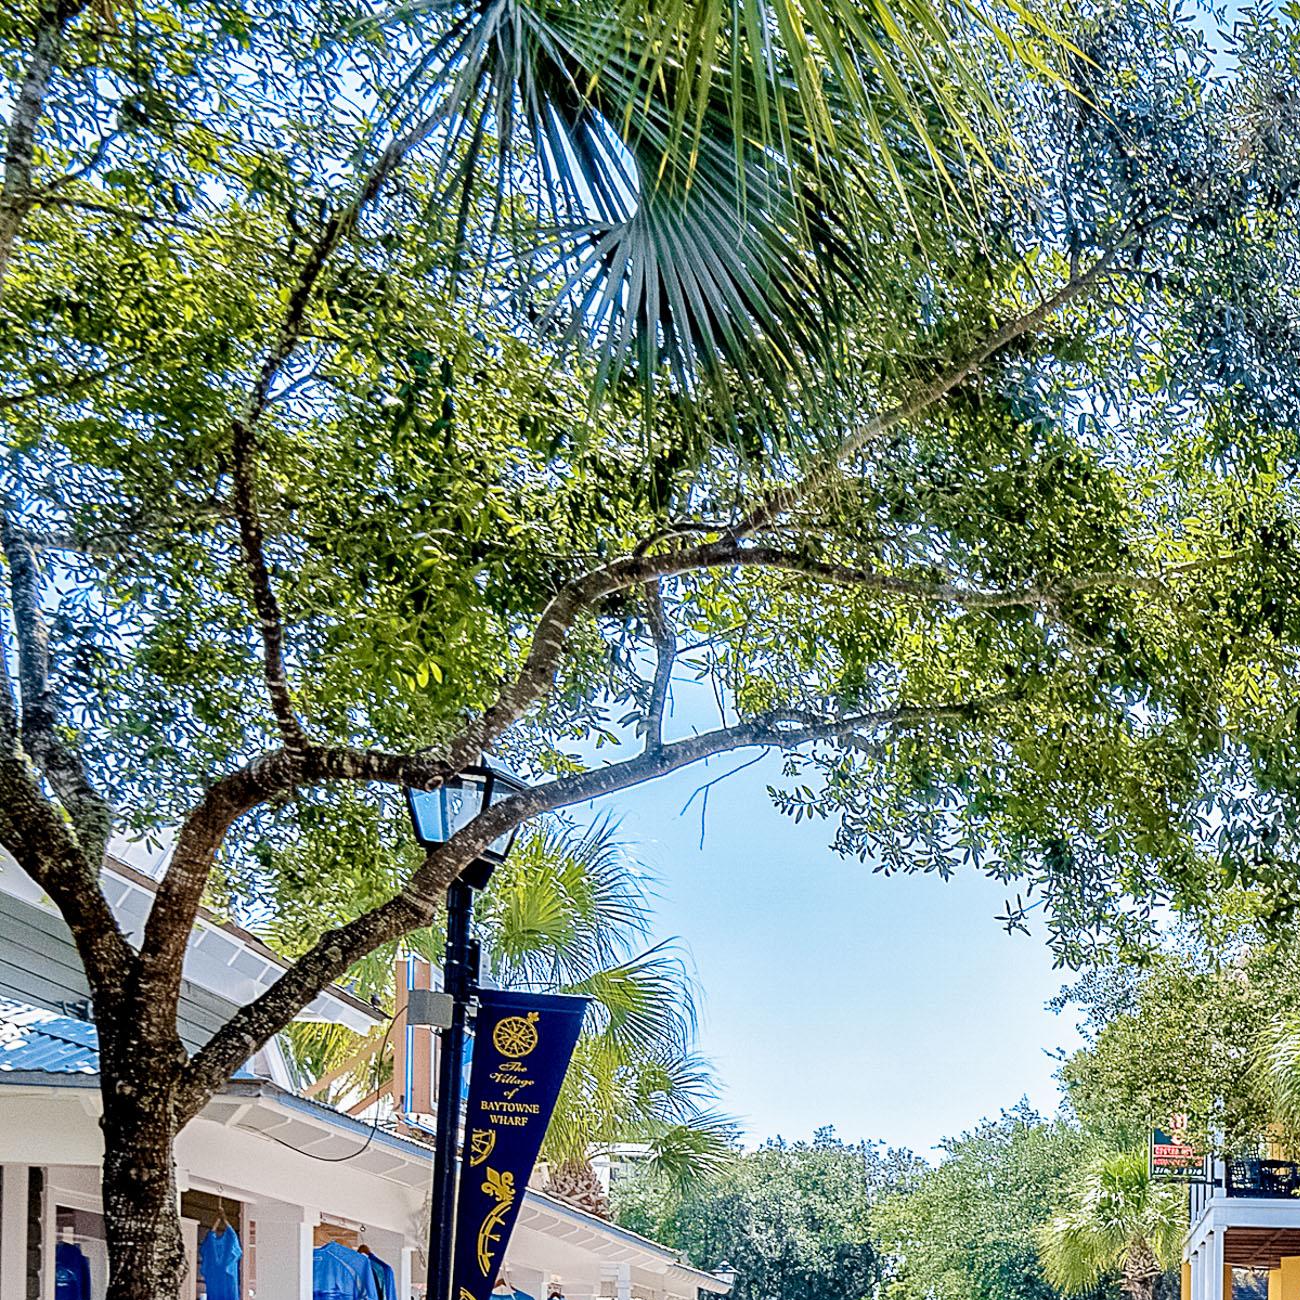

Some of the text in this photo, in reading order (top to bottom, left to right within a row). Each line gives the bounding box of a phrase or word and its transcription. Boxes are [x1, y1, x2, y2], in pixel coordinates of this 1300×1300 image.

[499, 1061, 528, 1073] The
[489, 1072, 535, 1087] Village
[503, 1087, 519, 1099] of
[480, 1100, 540, 1114] BAYTOWNE
[489, 1114, 528, 1126] WHARF
